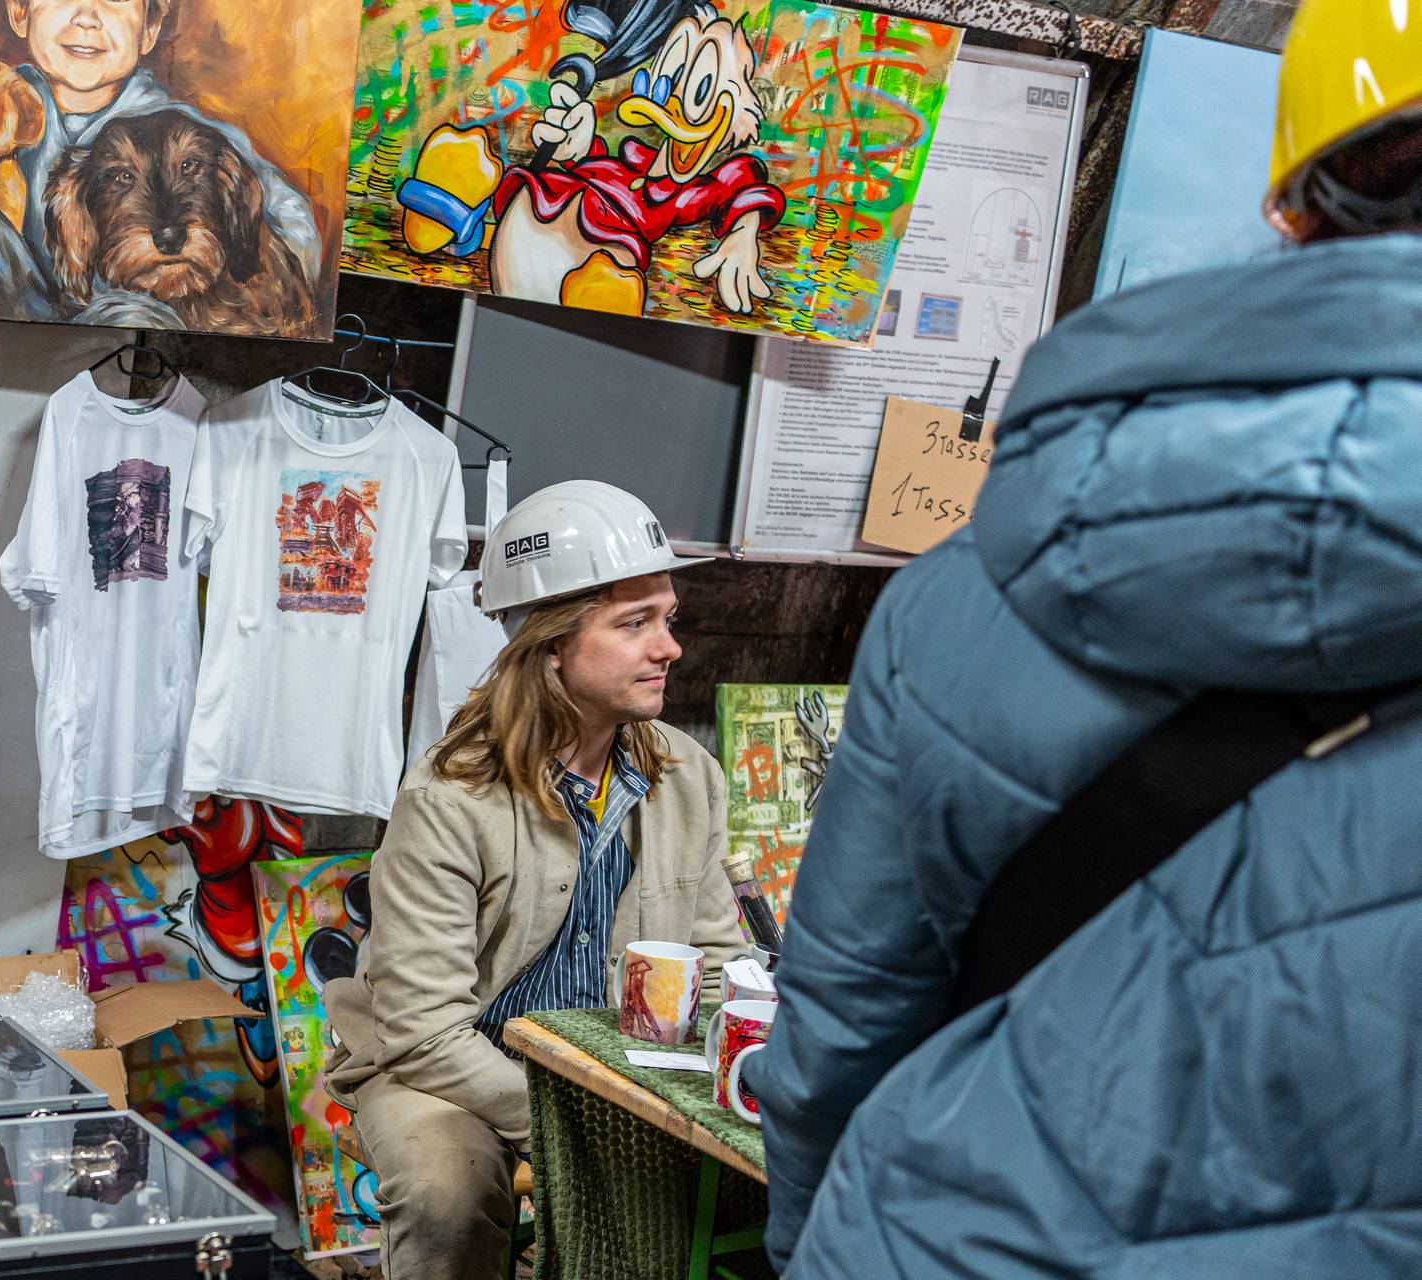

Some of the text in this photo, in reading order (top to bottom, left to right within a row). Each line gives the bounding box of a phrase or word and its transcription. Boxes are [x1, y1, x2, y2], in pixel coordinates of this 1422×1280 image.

[1027, 87, 1069, 110] RAG
[921, 420, 940, 454] 3
[891, 472, 913, 516] 1
[505, 532, 549, 559] RAG
